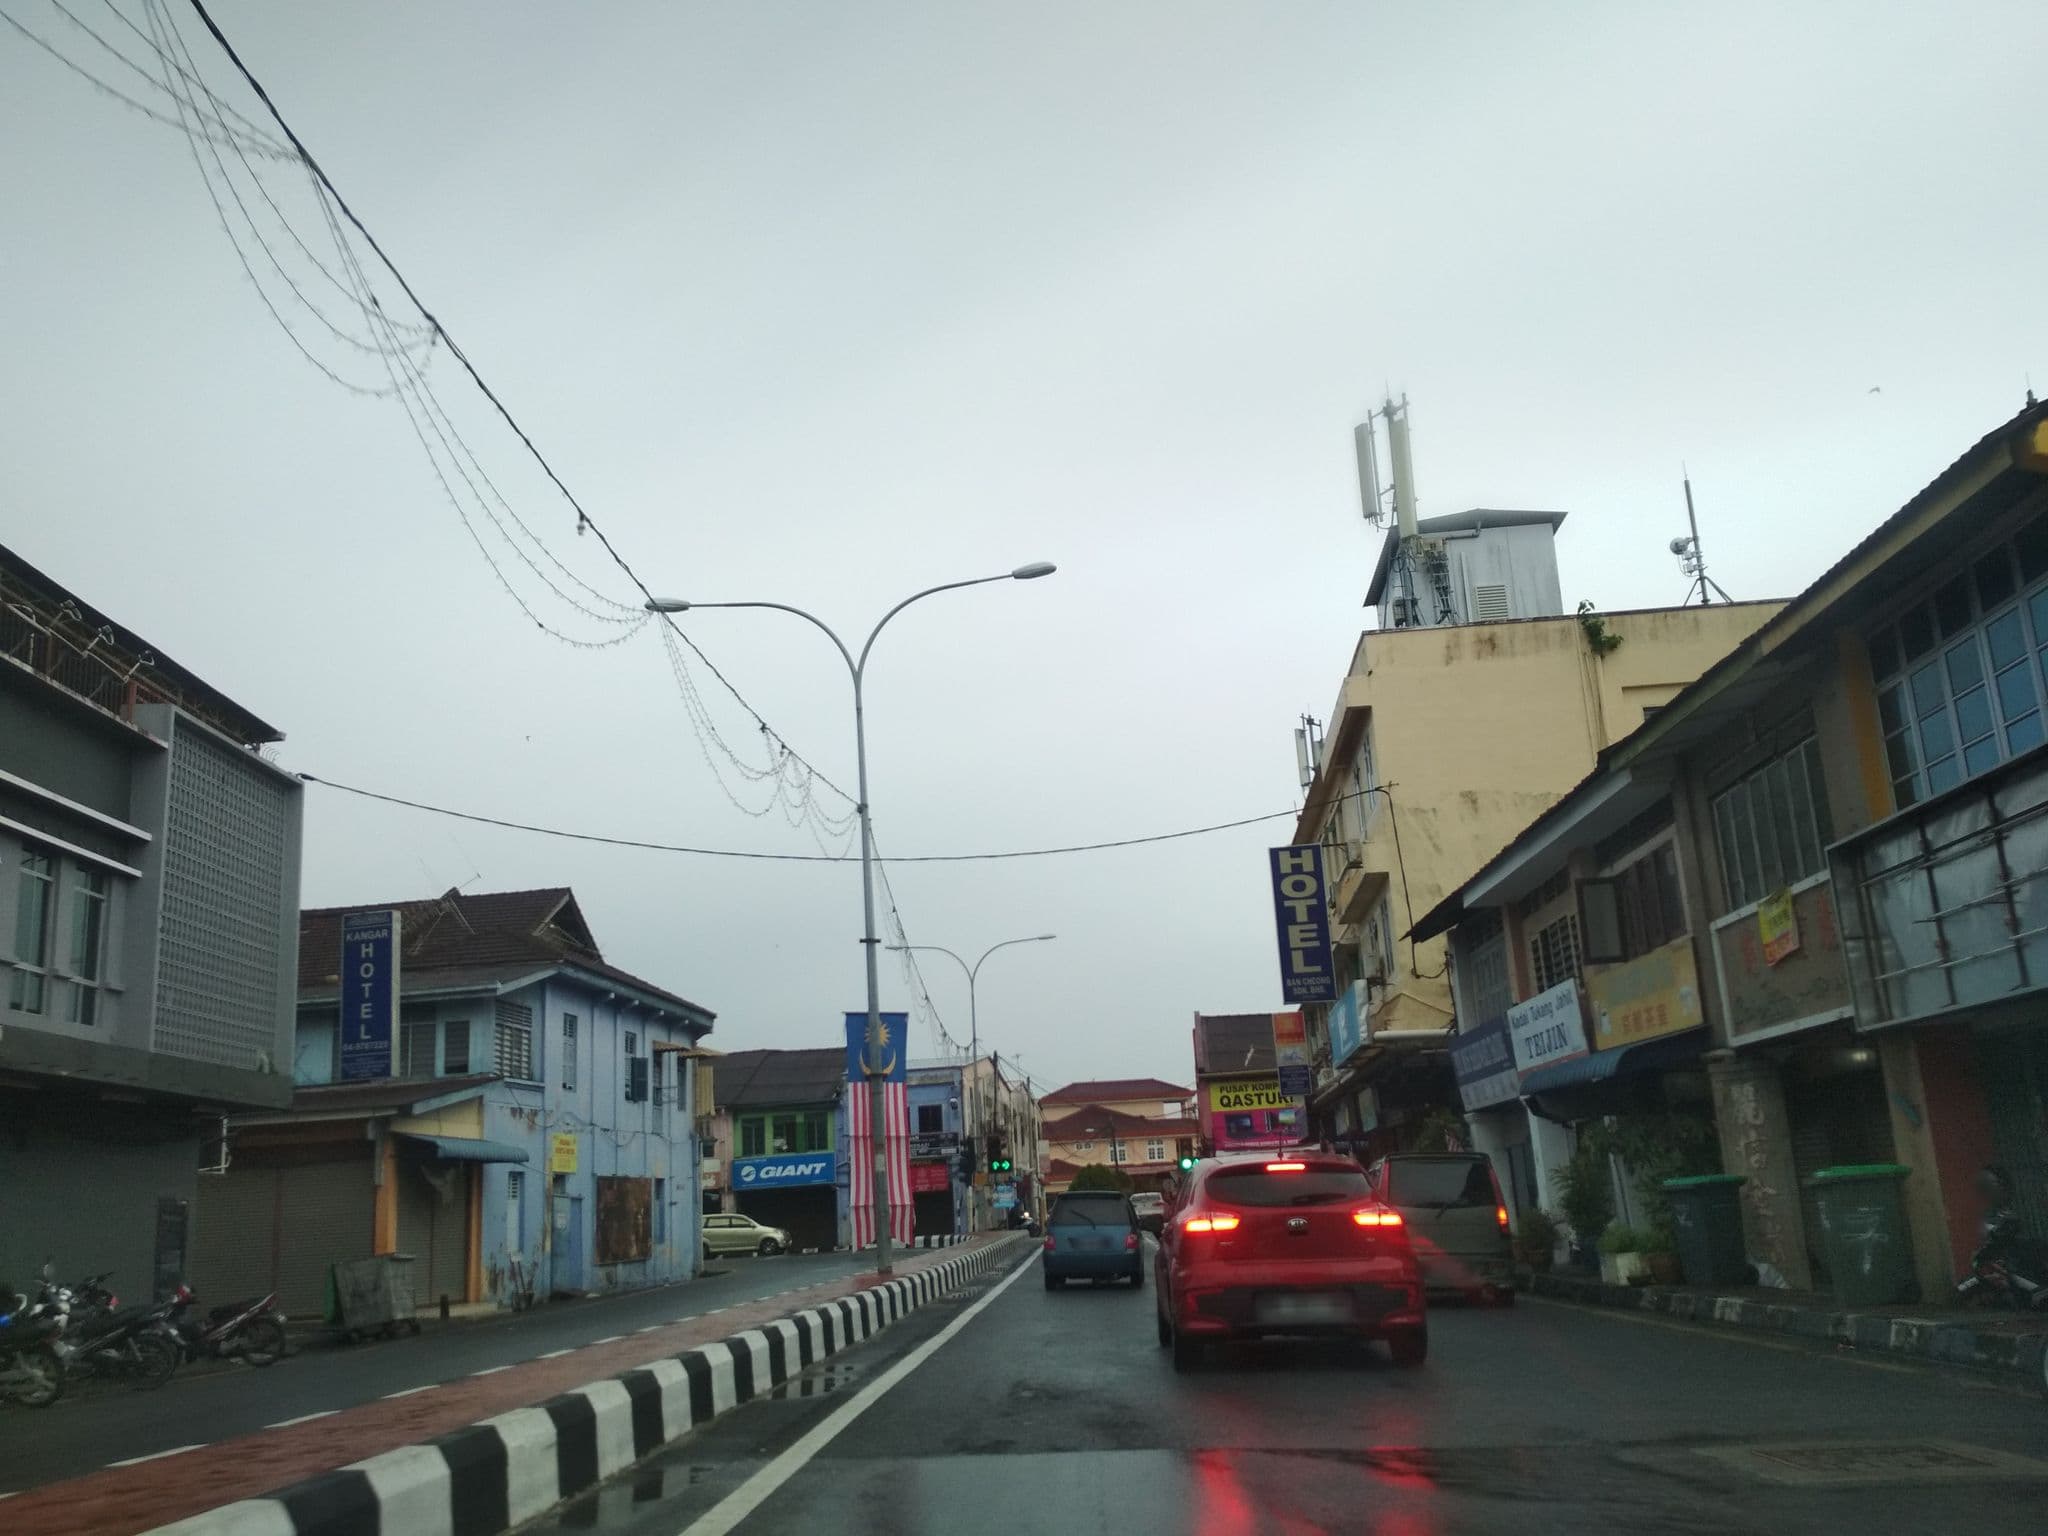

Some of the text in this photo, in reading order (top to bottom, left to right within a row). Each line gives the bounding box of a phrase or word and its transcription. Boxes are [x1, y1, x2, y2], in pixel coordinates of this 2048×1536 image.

[1279, 849, 1322, 974] HOTEL
[345, 928, 388, 942] KANGAR
[360, 942, 375, 1040] HOTEL
[1525, 1022, 1569, 1059] TEIJIN
[1220, 1082, 1249, 1093] PUSAT
[760, 1162, 826, 1179] GIANT
